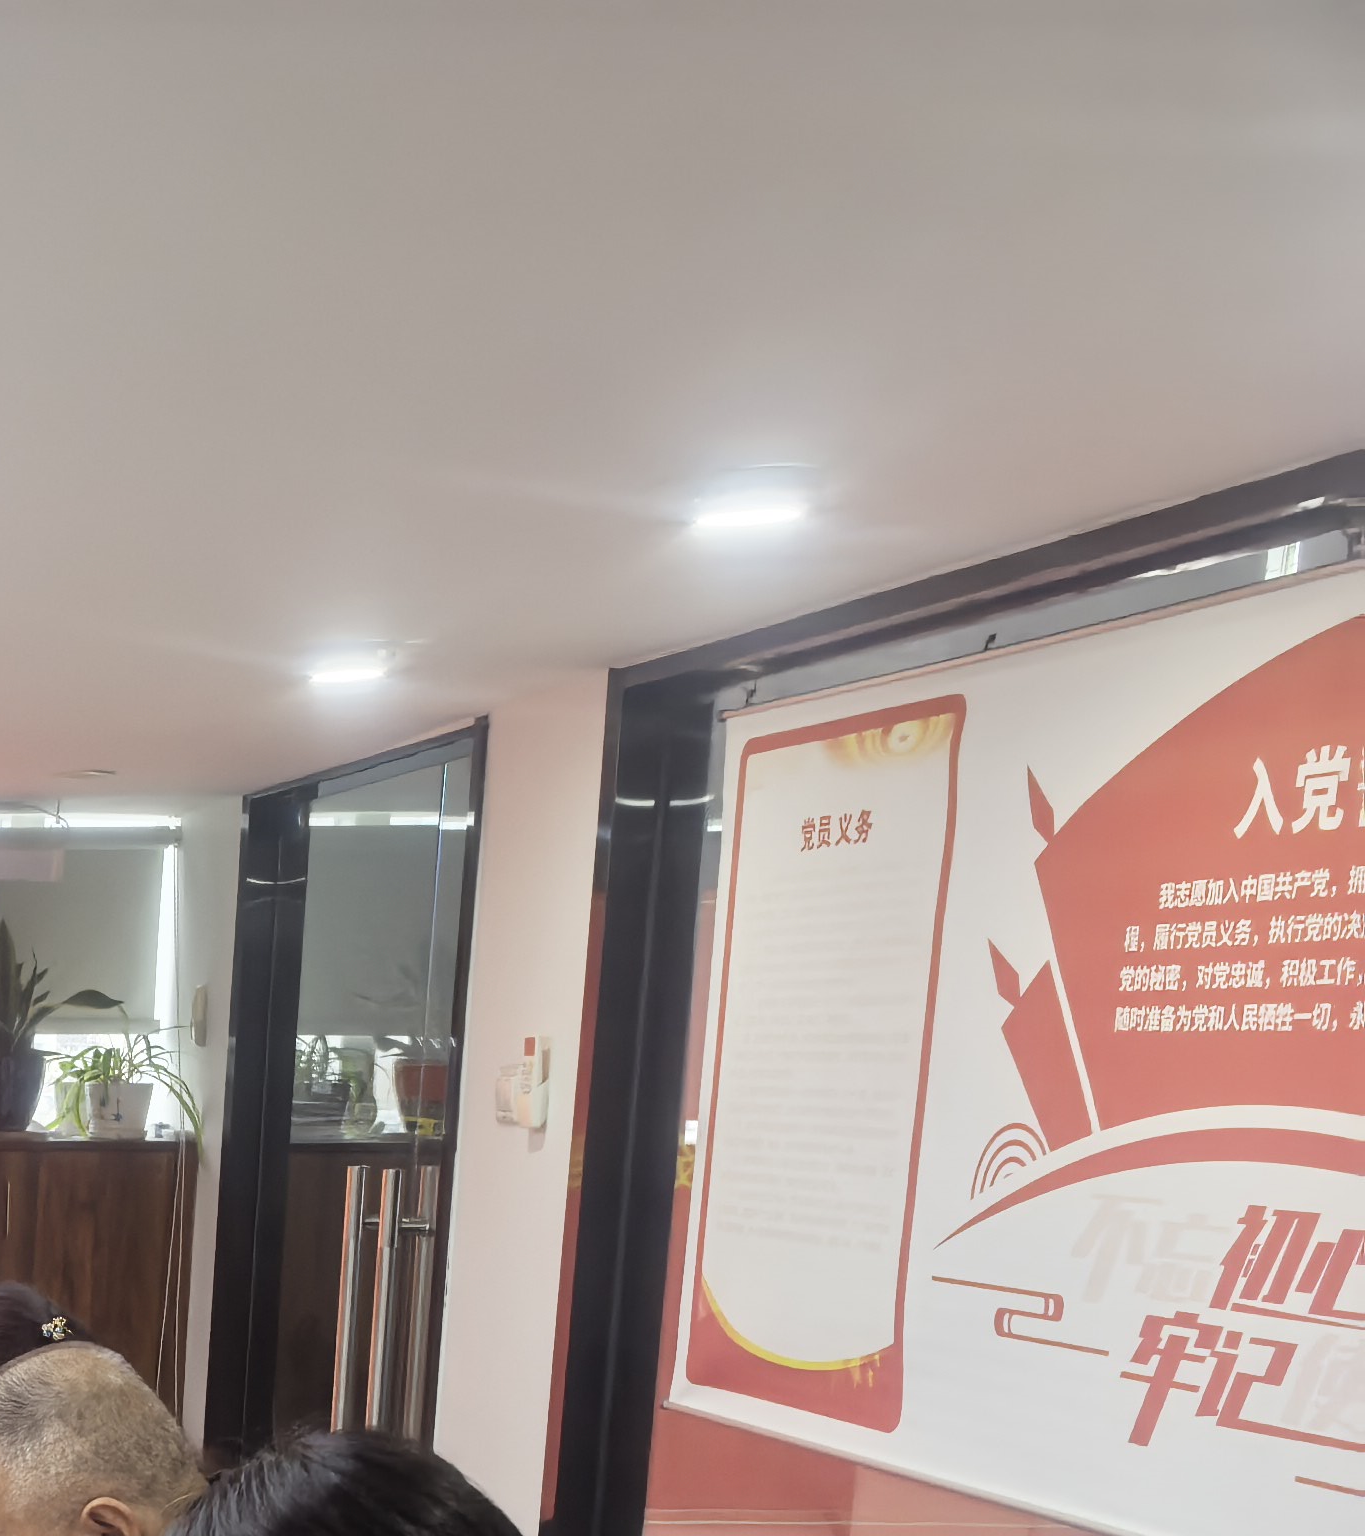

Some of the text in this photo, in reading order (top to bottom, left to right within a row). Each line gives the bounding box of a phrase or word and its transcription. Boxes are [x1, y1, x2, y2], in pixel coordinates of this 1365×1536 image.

[1233, 744, 1365, 840] 入党
[800, 808, 874, 852] 党员义务
[1124, 909, 1365, 953] 程，履行党员义务，执行党的决
